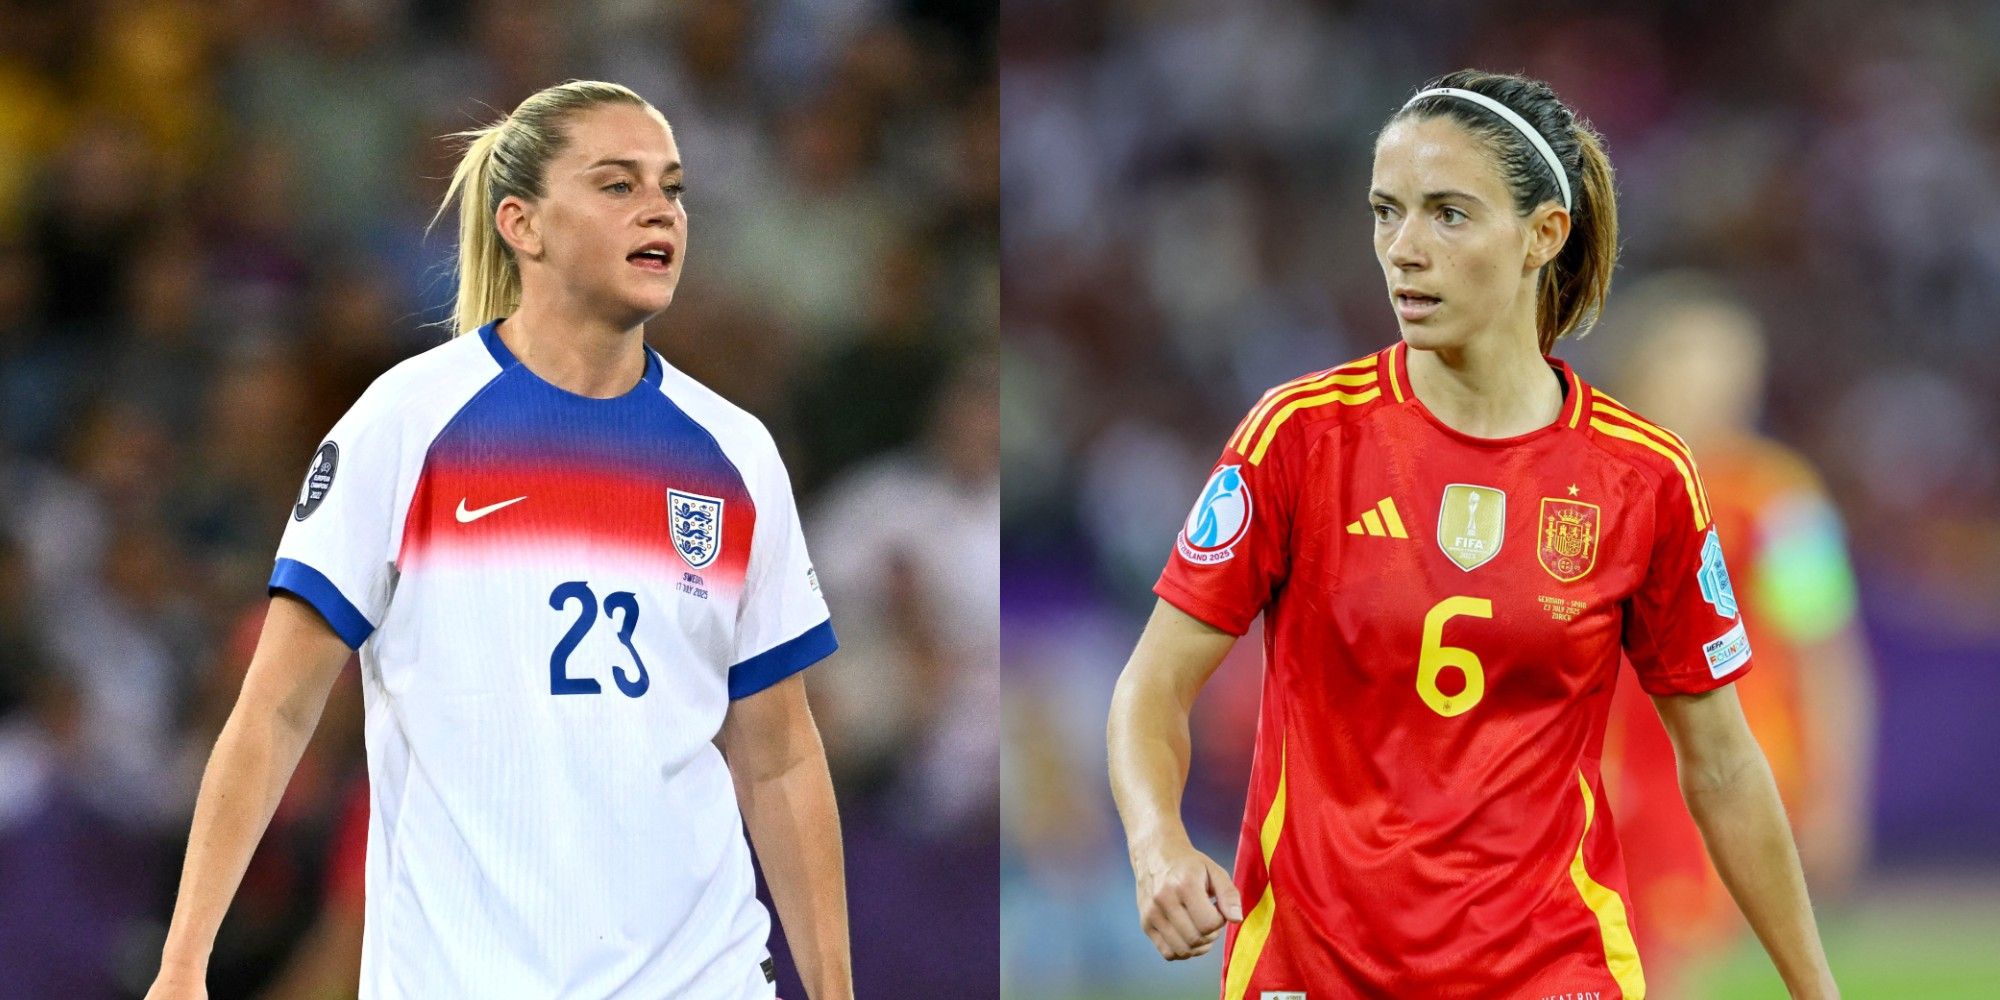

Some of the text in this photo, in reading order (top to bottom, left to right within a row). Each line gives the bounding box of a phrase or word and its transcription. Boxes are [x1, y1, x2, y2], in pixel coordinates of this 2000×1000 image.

[1455, 536, 1484, 550] FIFA
[1209, 549, 1230, 561] 2025
[693, 587, 709, 600] 2025
[1552, 605, 1565, 613] JULY
[549, 581, 650, 698] 23
[1706, 640, 1724, 652] UEFA
[1416, 595, 1493, 718] 6
